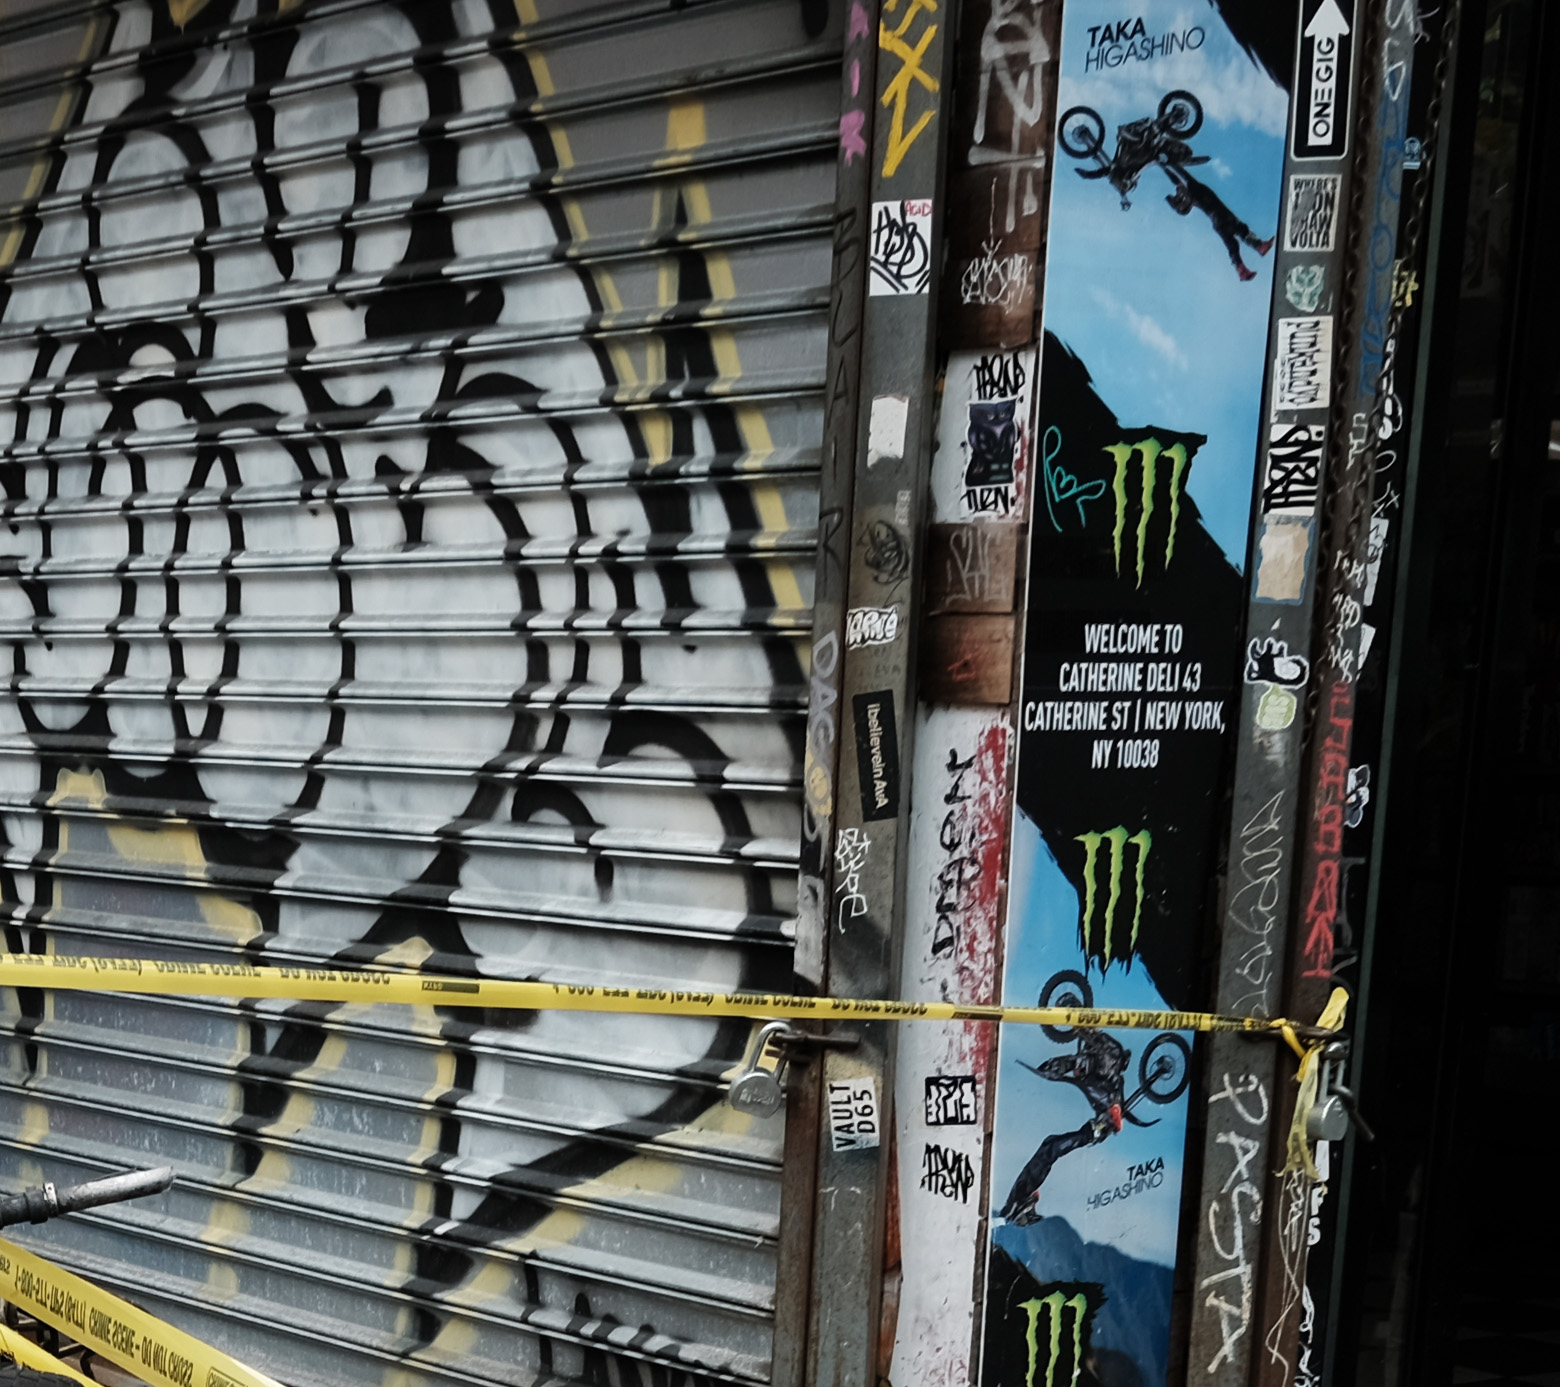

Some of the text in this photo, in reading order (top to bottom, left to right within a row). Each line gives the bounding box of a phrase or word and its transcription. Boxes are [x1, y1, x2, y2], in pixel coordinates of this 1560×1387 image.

[1088, 19, 1147, 46] TAKA
[1085, 26, 1205, 73] HIGASHINO
[1084, 623, 1183, 654] WELCOME TO
[1059, 662, 1202, 692] CATHERINE DELI 43
[1024, 701, 1109, 731] CATHERINE
[1111, 701, 1132, 731] ST
[1145, 701, 1182, 730] NEW
[1184, 701, 1226, 735] YORK,
[1091, 739, 1160, 769] NY 10038
[832, 1082, 858, 1151] VAULT
[856, 1089, 876, 1134] D65
[1127, 1157, 1165, 1182] TAKA
[1086, 1171, 1164, 1211] HIGASHINO
